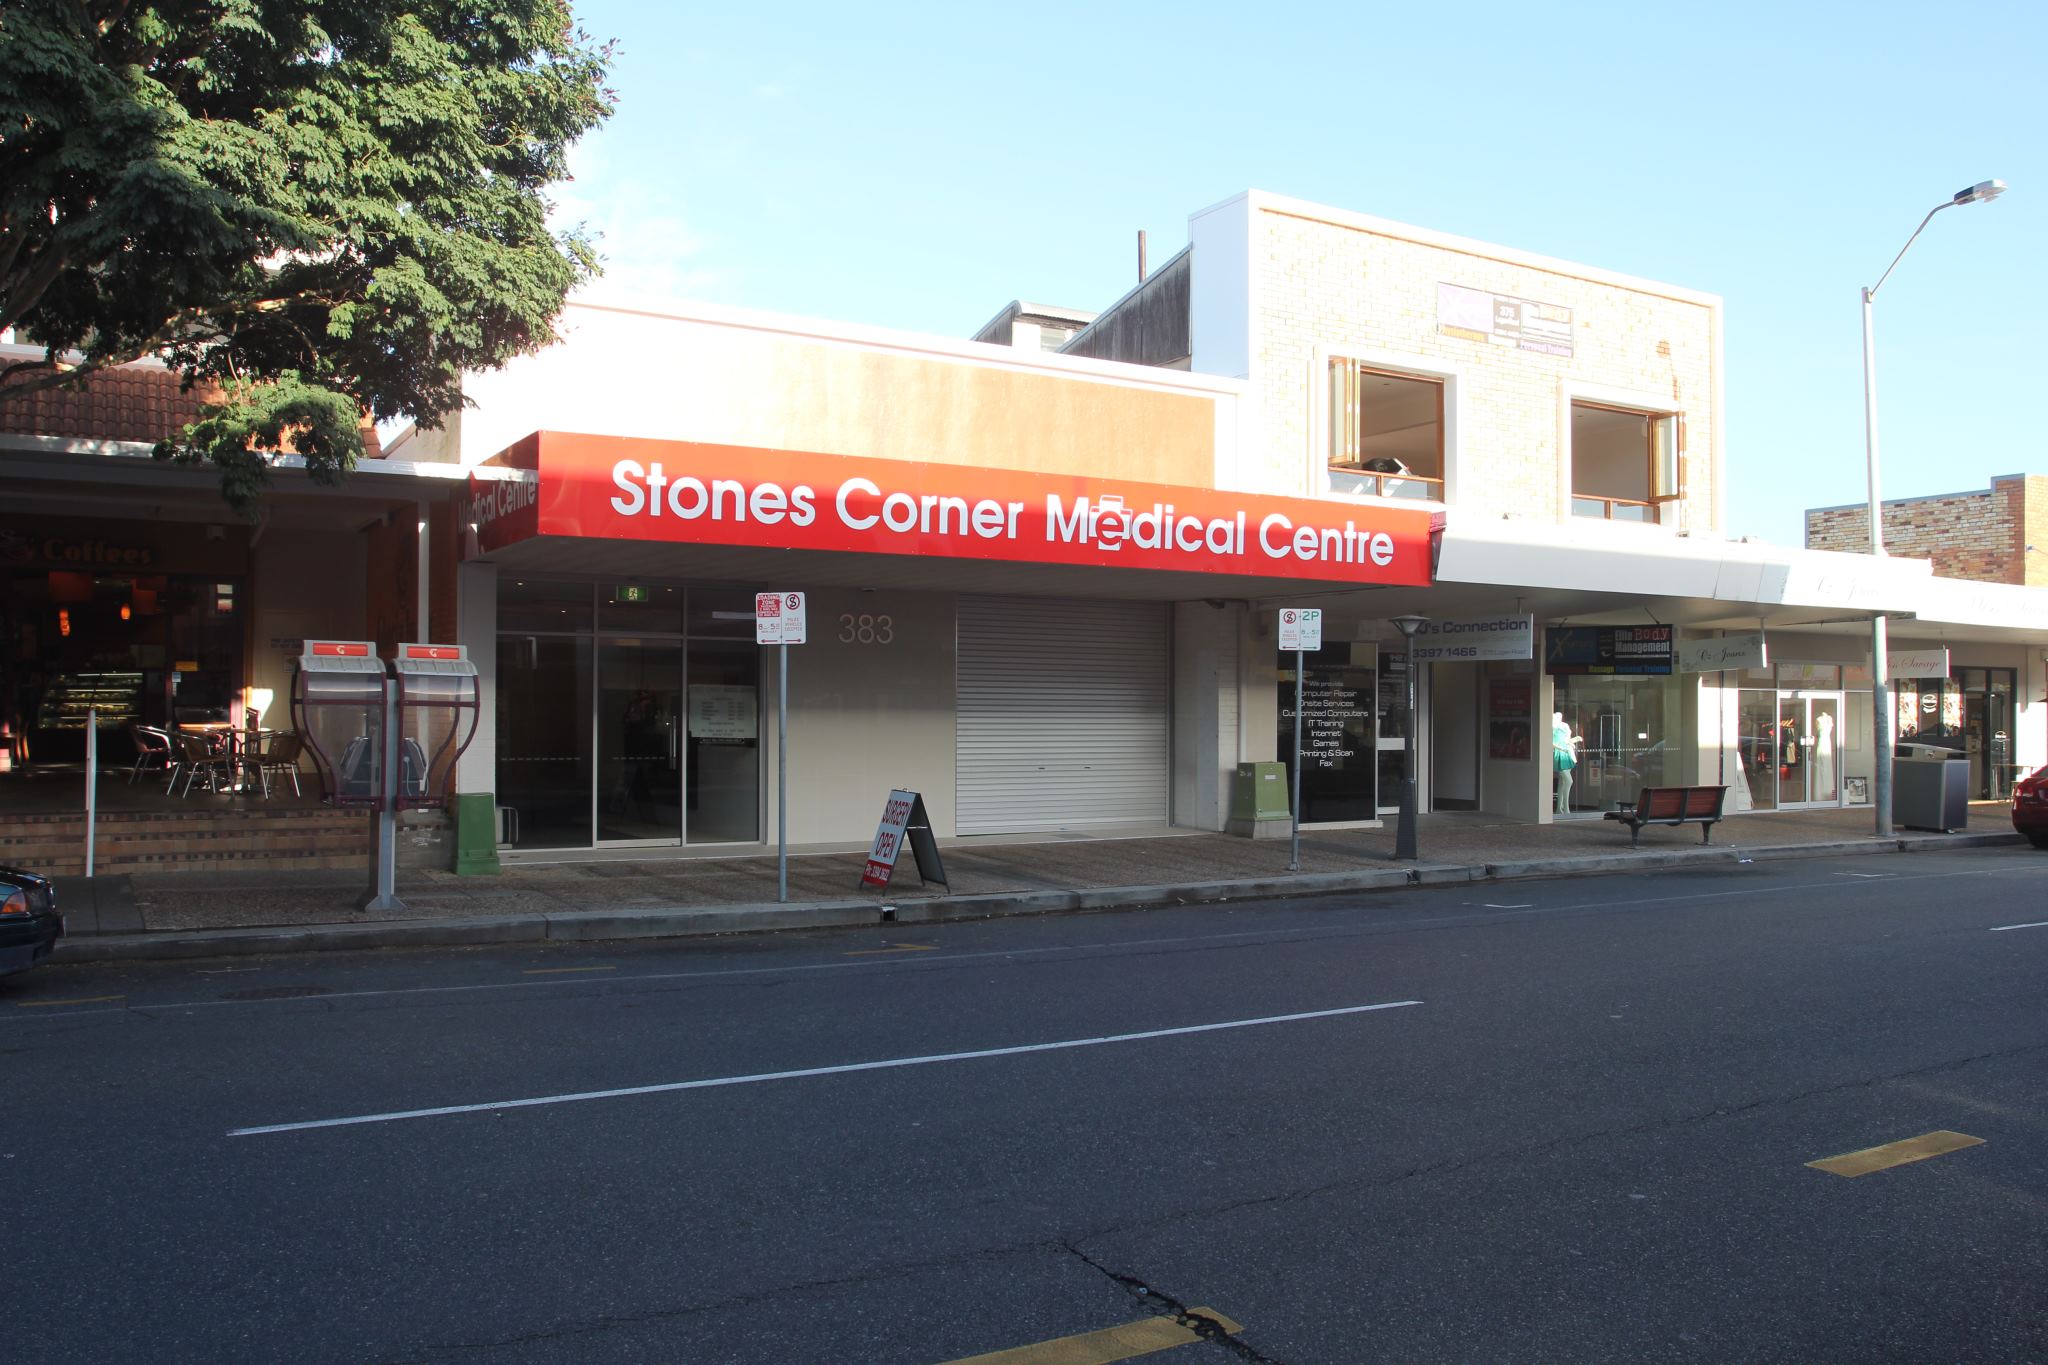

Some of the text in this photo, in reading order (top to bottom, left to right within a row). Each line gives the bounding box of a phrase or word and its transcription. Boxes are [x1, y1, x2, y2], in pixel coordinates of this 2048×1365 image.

[610, 459, 1394, 566] Stones Corner Medical Centre
[43, 538, 153, 566] Coffees
[1302, 610, 1319, 621] 2P
[839, 614, 893, 644] 383
[1443, 619, 1528, 634] Connection
[1412, 647, 1443, 659] 3397
[1446, 646, 1477, 657] 1466
[1615, 640, 1670, 654] Management
[1333, 690, 1358, 698] Repair
[1327, 710, 1369, 718] Computers
[1318, 720, 1344, 728] Training
[1299, 750, 1327, 758] Printing
[882, 799, 913, 826] SURGERY
[875, 832, 897, 858] OPEN
